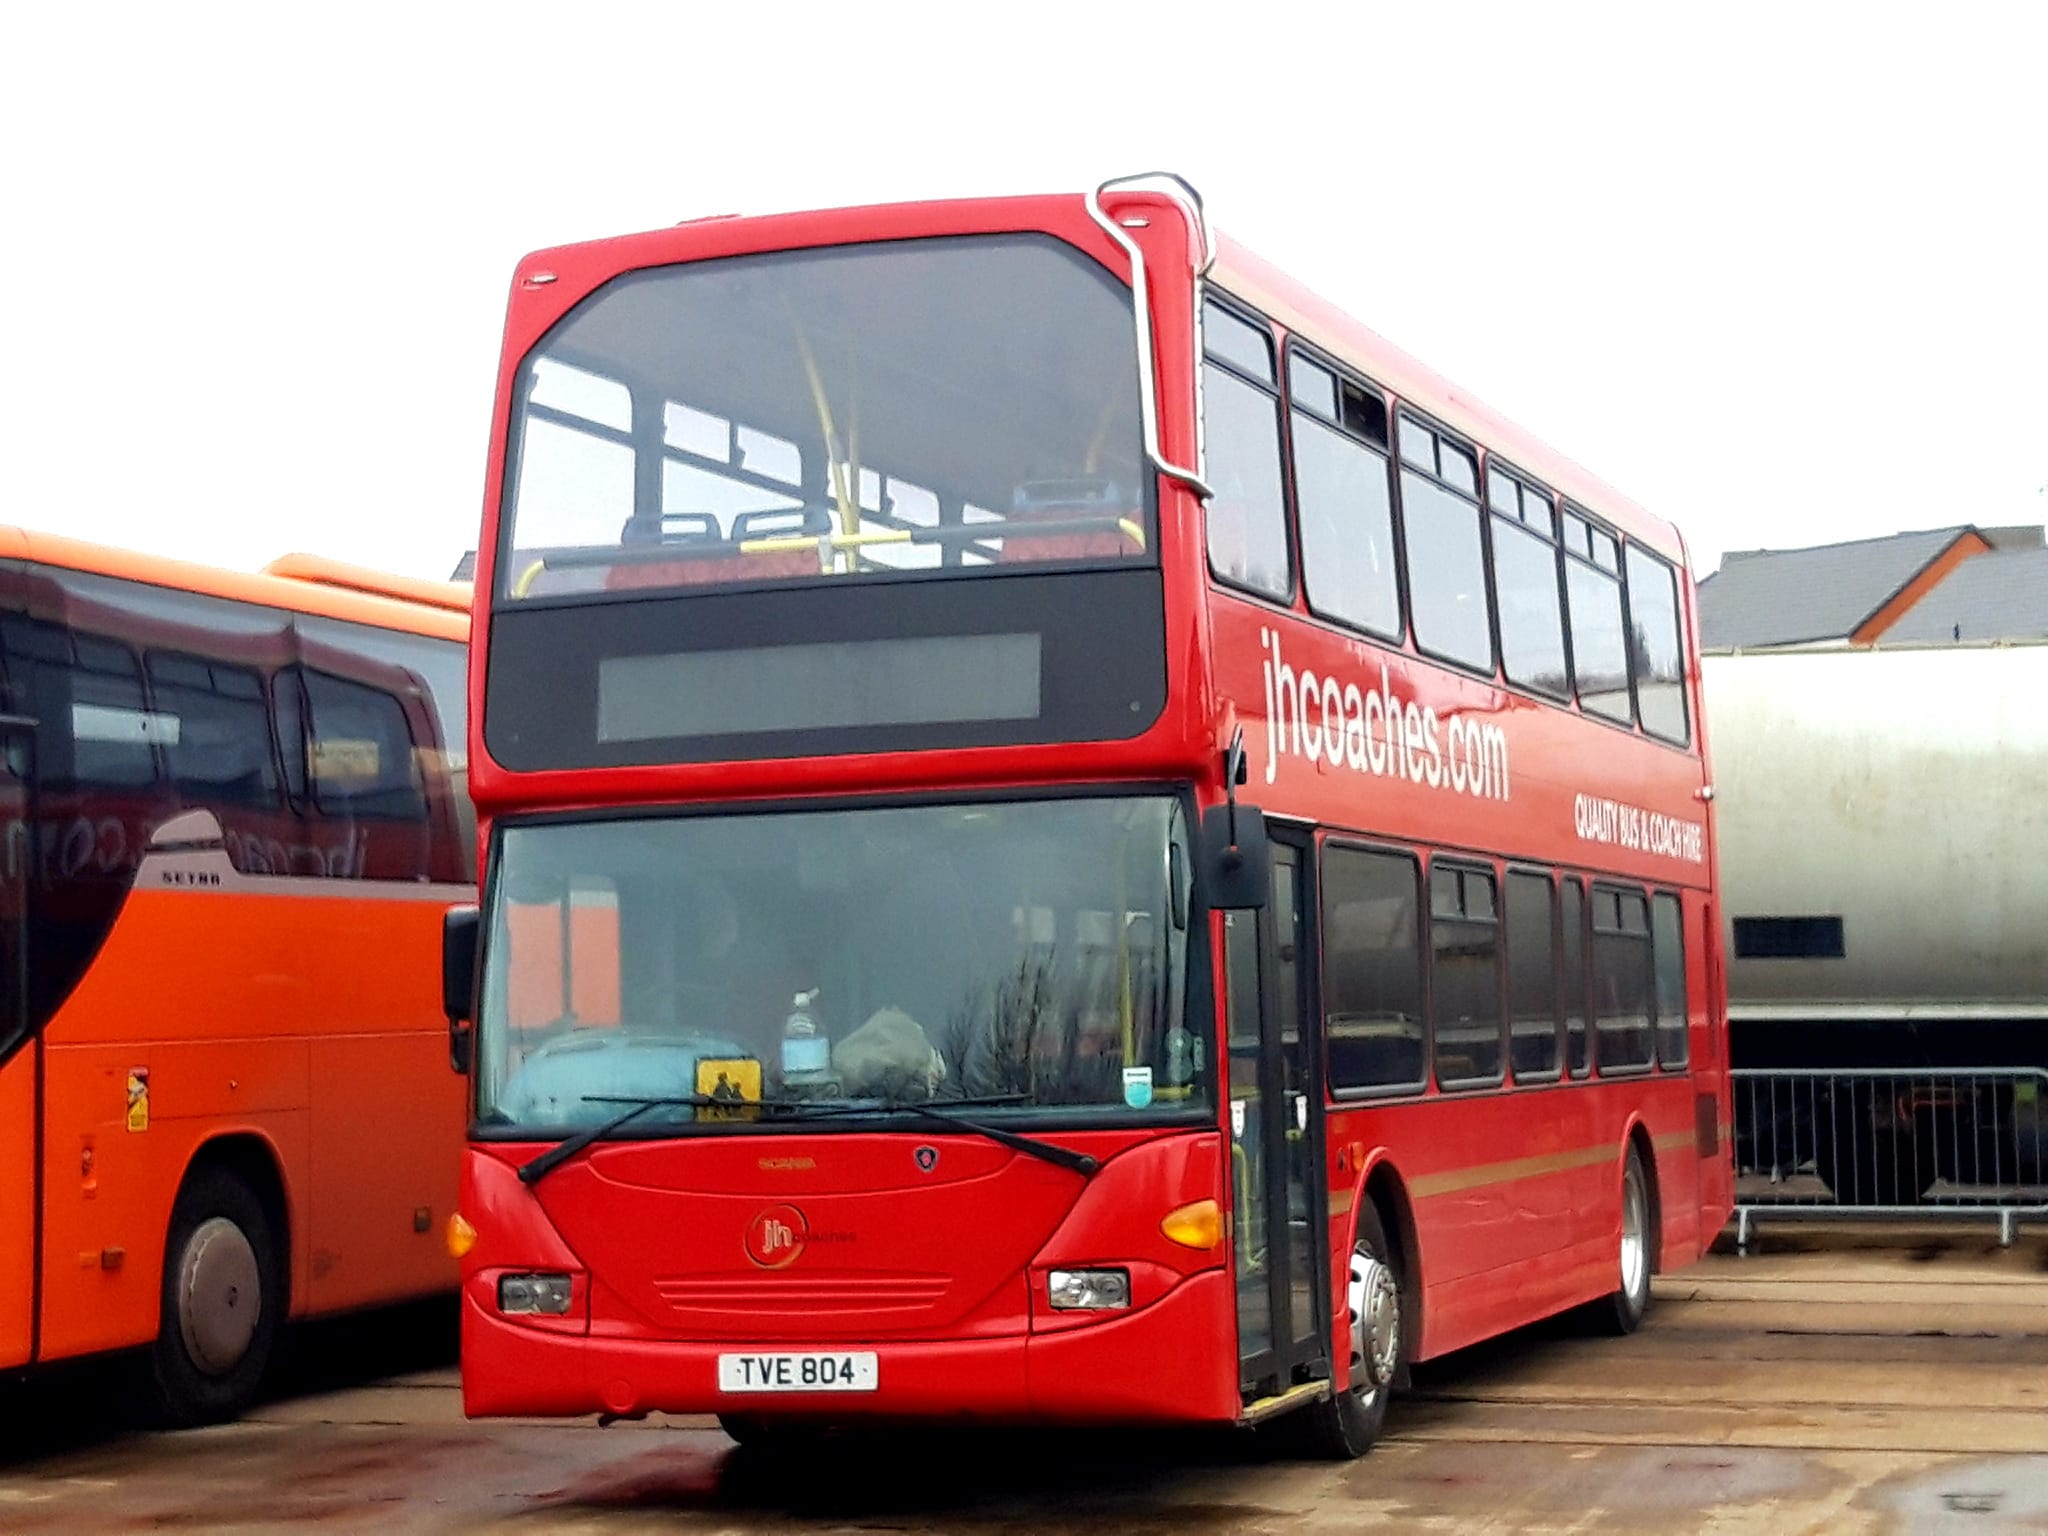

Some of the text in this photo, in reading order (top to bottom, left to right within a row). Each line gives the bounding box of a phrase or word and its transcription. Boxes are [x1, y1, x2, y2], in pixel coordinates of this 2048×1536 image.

[1261, 626, 1511, 801] jhcoaches.com
[1574, 791, 1619, 844] QUALITY
[1619, 803, 1640, 850] BUS
[1650, 811, 1682, 858] COACH
[740, 1356, 855, 1385] TVE 804
